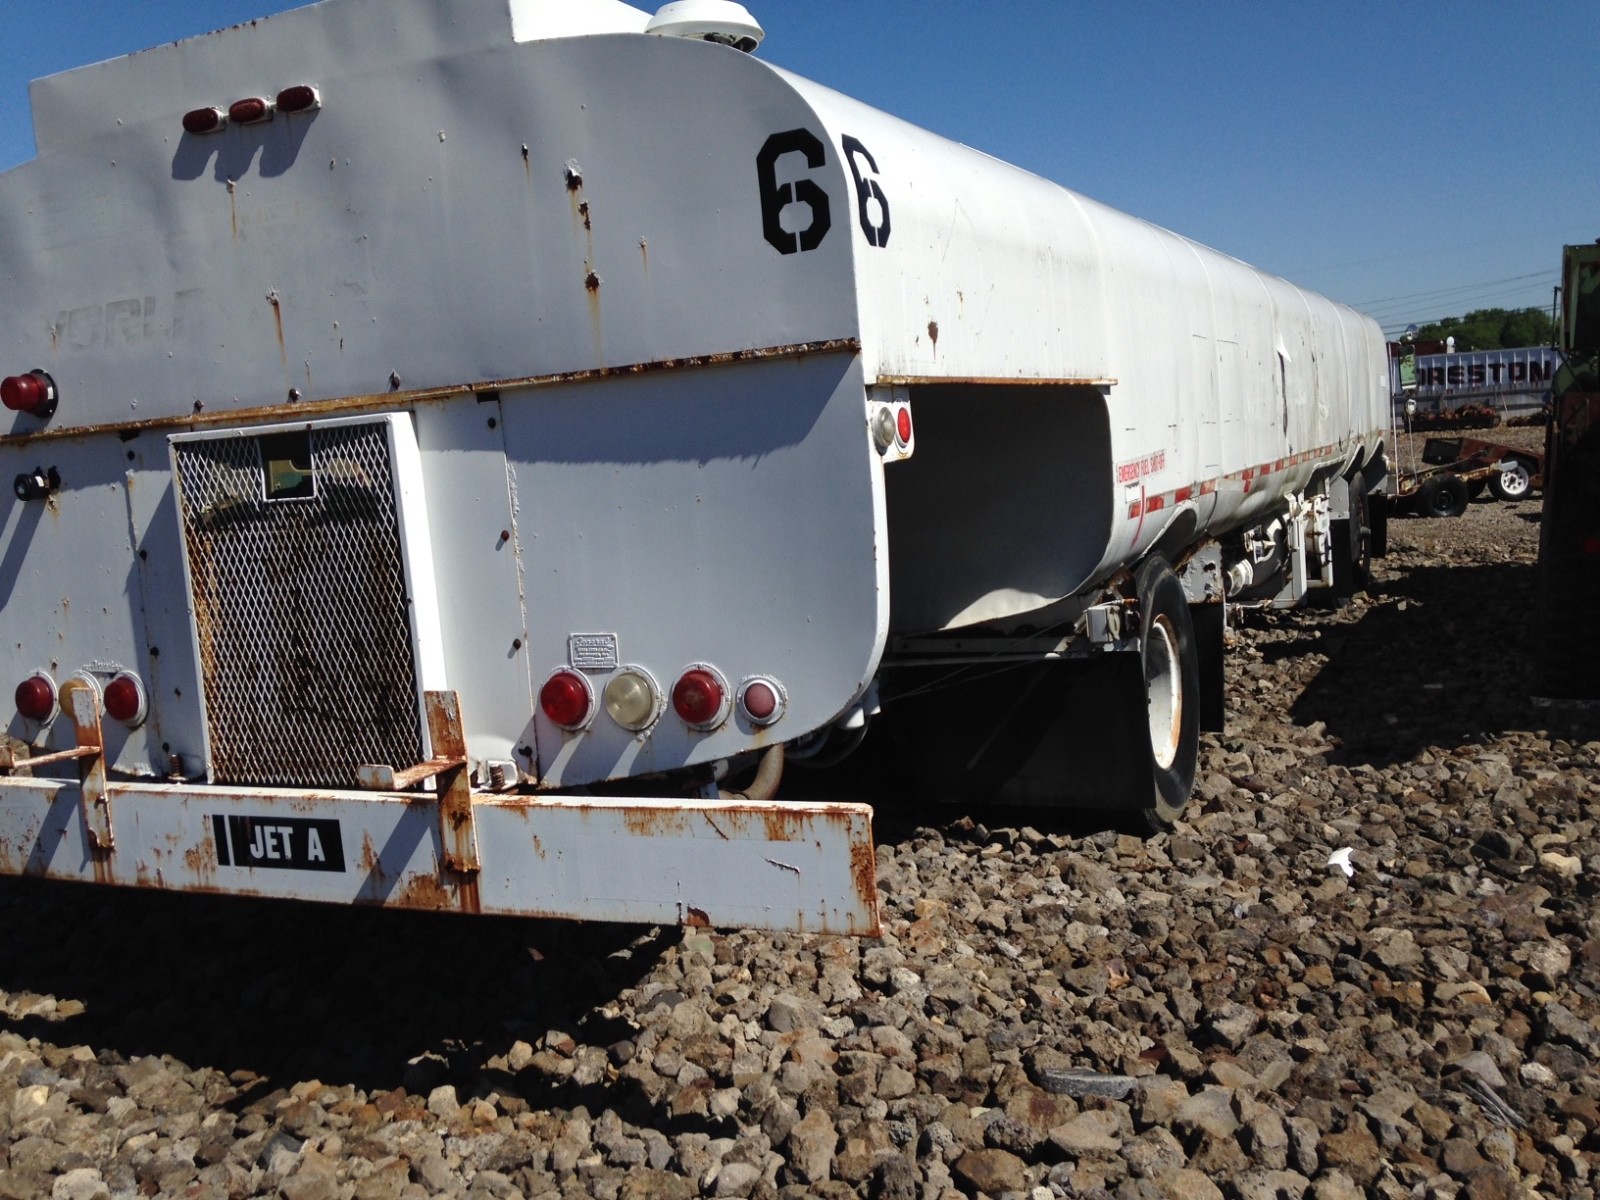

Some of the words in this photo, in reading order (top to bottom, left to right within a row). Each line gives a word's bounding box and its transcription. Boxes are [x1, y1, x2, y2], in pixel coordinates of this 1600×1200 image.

[756, 127, 831, 255] 6
[841, 133, 891, 248] 6
[1119, 462, 1140, 483] EMERGENCY
[1141, 459, 1150, 476] FUEL
[249, 825, 294, 860] JET
[307, 827, 326, 862] A
